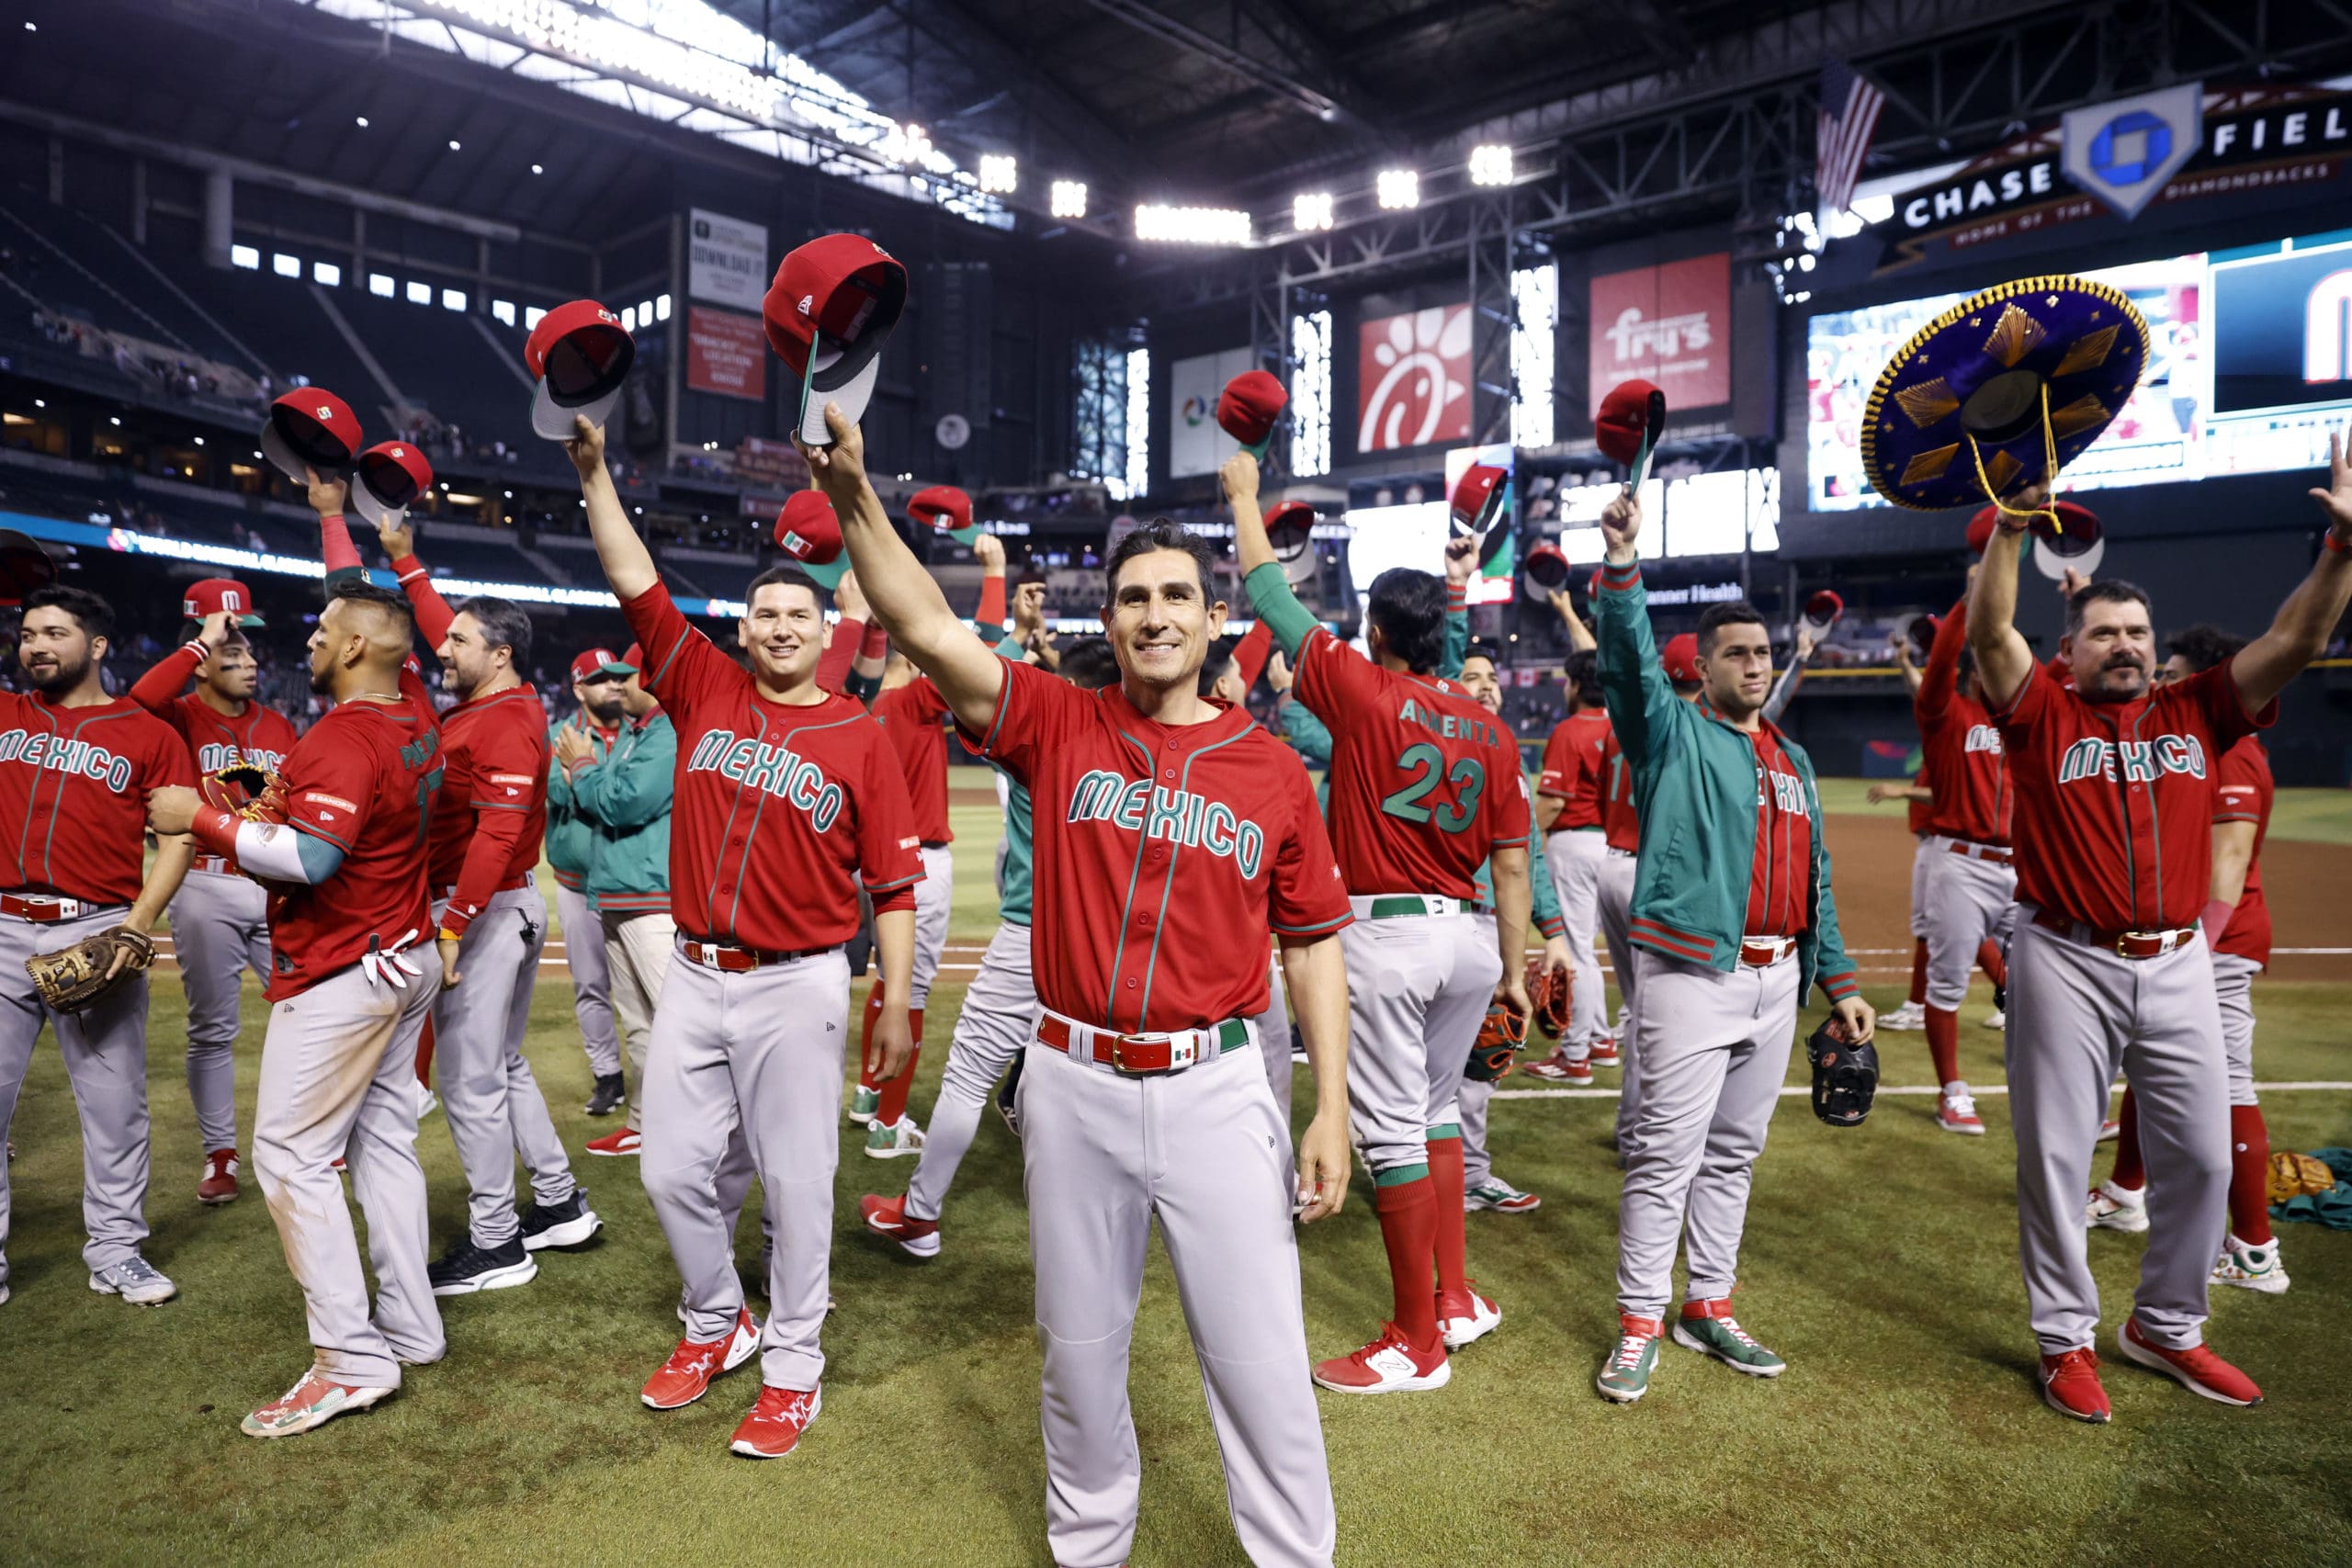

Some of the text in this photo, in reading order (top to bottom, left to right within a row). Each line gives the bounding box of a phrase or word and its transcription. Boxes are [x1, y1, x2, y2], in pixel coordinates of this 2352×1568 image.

[1904, 162, 2052, 228] CHASE
[2165, 162, 2328, 200] DIAMONDBACKS
[1955, 200, 2094, 246] HOME OF THE
[1605, 308, 1712, 361] fry's
[1646, 581, 1743, 606] anner Health
[1398, 698, 1499, 750] ARMENTA
[0, 728, 131, 794] MEXICO
[198, 742, 287, 776] MEXIC
[687, 729, 842, 833] MEXICO
[2058, 734, 2206, 784] MEXICO
[1381, 742, 1486, 835] 23
[1067, 770, 1264, 880] MEXICO
